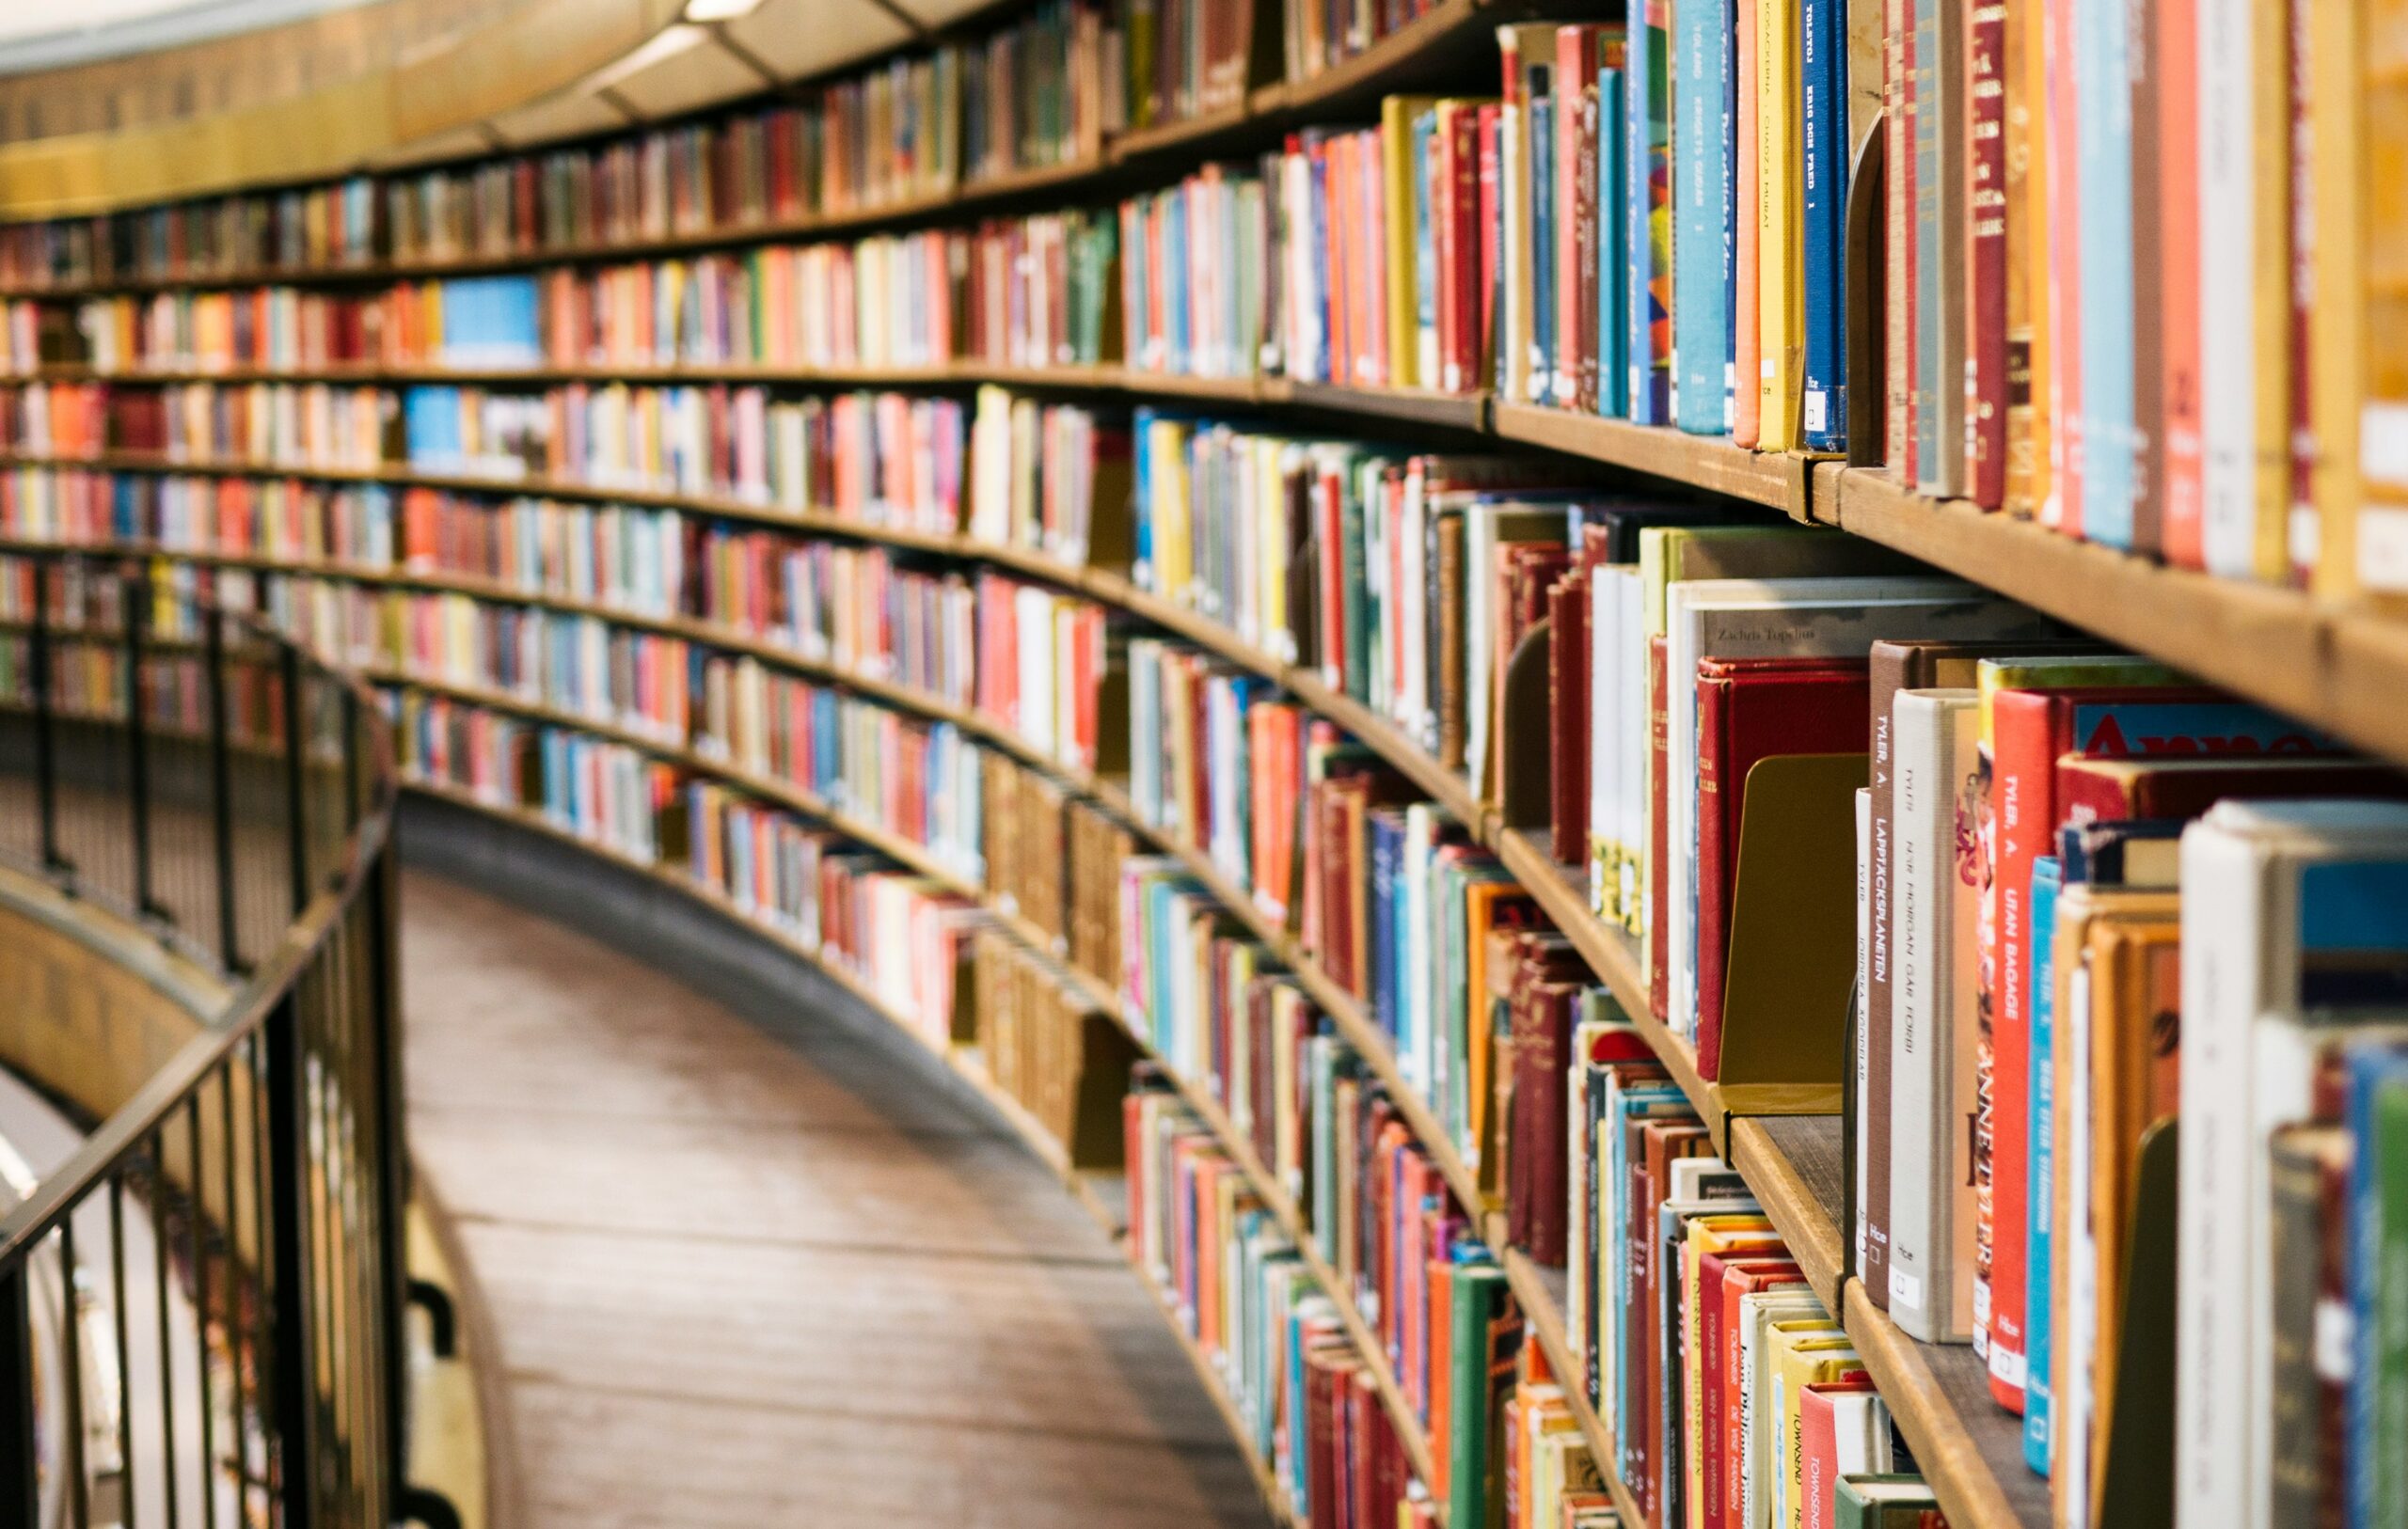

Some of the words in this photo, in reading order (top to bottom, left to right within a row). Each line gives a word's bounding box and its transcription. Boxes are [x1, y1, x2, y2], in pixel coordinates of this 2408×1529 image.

[1807, 152, 1815, 190] FRED
[1876, 715, 1888, 764] TYLER,
[1876, 770, 1887, 788] A.
[1905, 769, 1914, 812] TYLER
[2004, 775, 2018, 829] TYLER,
[1875, 817, 1887, 983] LAPPTÄCKSPLANETEN
[1905, 881, 1915, 954] MORGAN
[2004, 888, 2018, 937] UTAN
[2004, 942, 2019, 1020] BAGAGE
[1794, 1413, 1802, 1486] TOWNSEND
[1810, 1457, 1821, 1529] TOWNSEND
